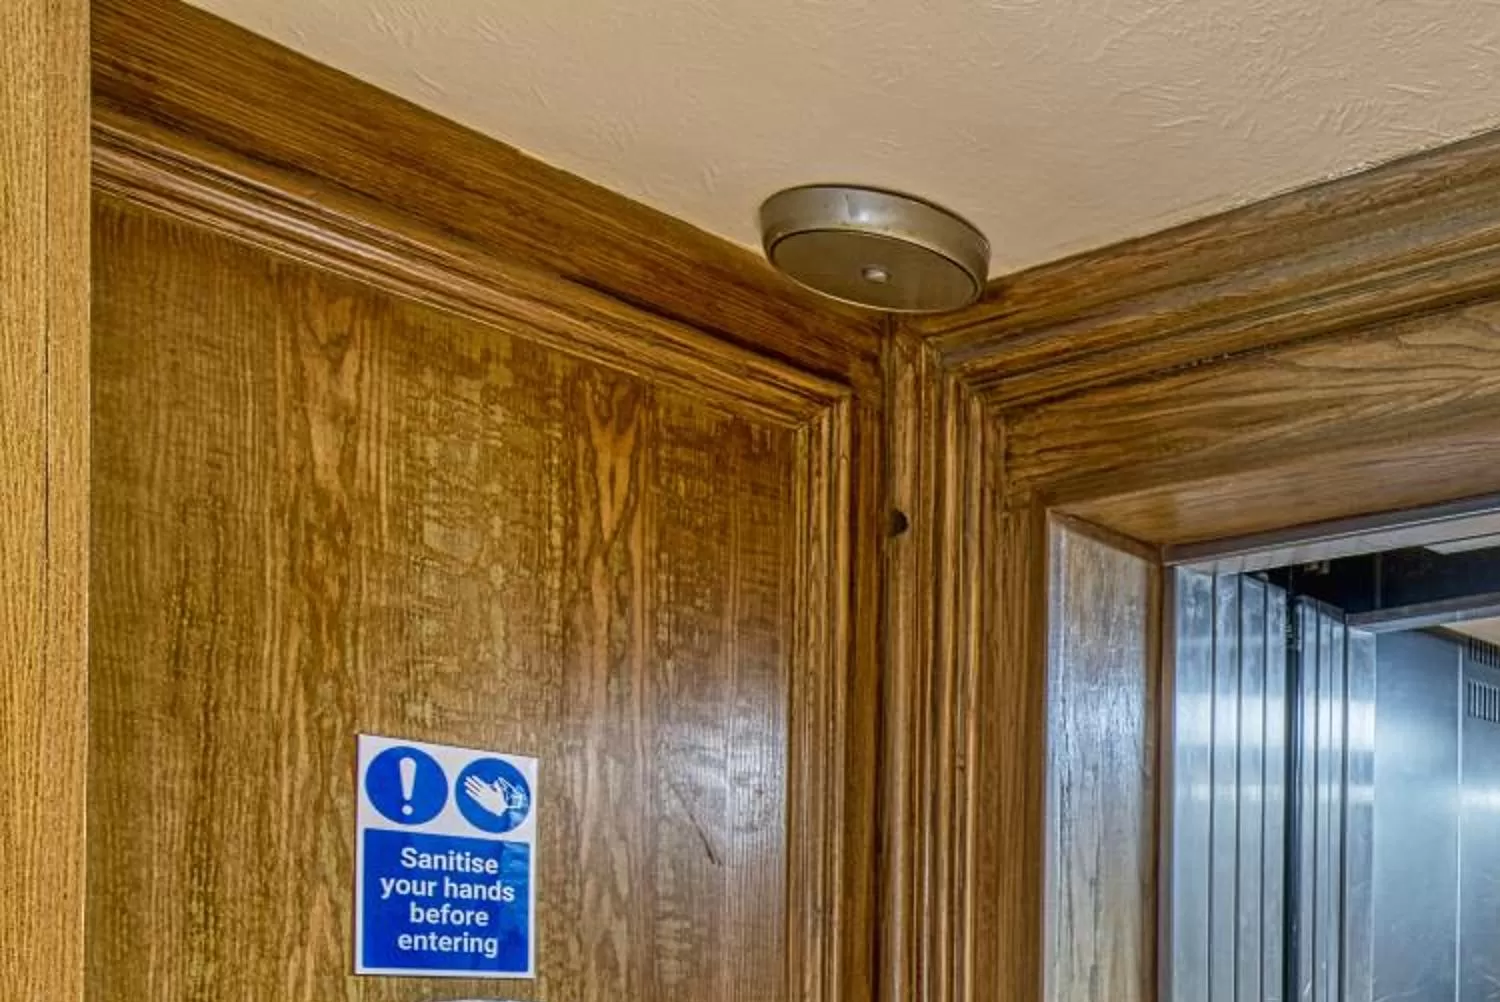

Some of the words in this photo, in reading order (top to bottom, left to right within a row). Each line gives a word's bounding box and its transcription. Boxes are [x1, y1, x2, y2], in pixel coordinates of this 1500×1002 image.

[400, 847, 498, 874] Sanitise
[380, 877, 437, 899] your
[444, 876, 515, 902] hands
[409, 902, 489, 926] before
[397, 932, 498, 959] entering
